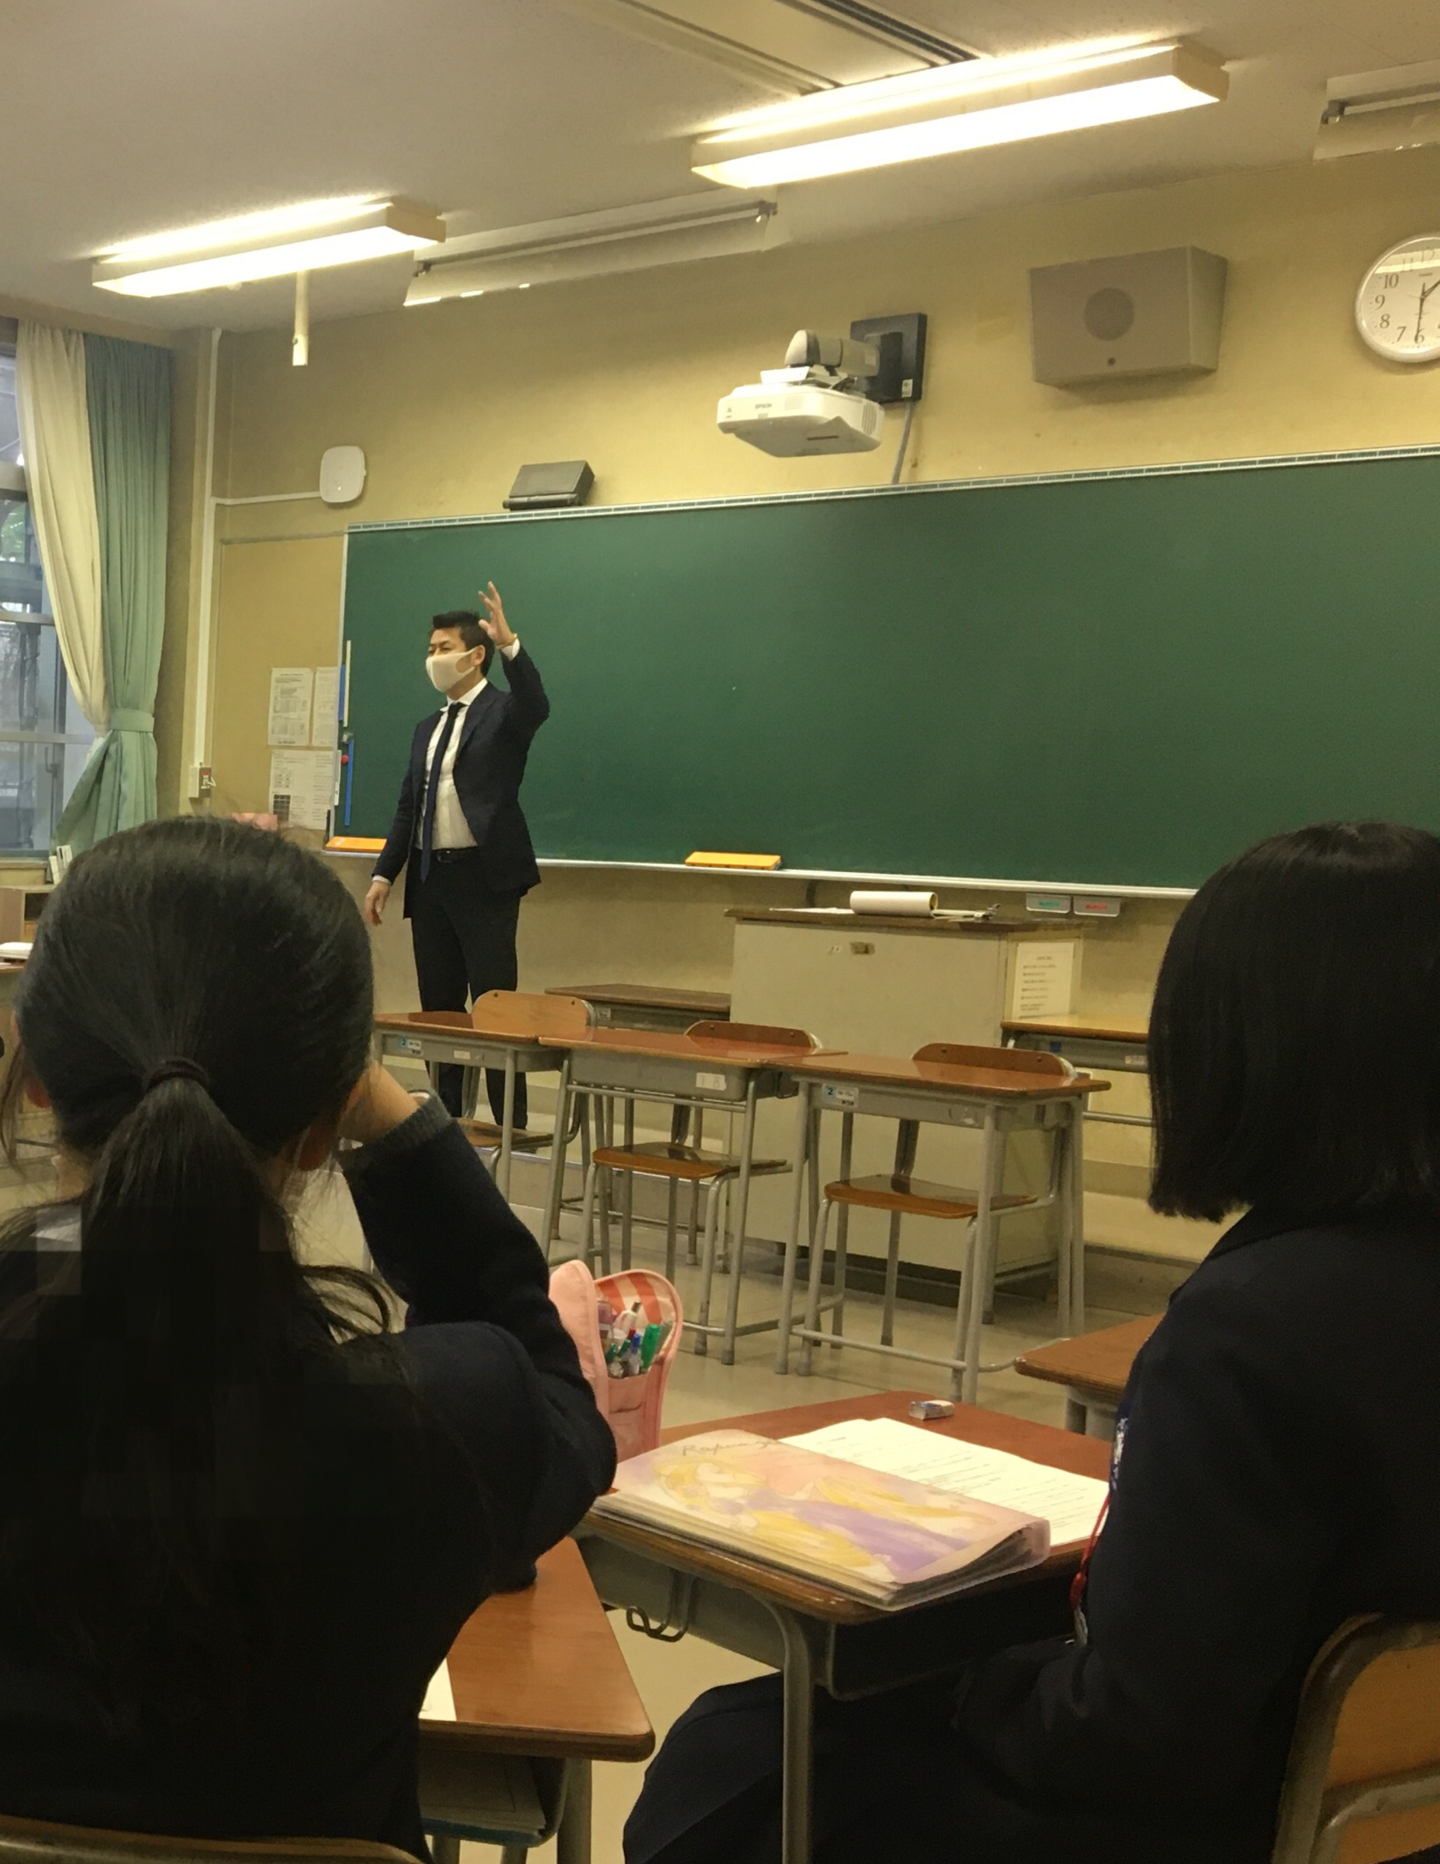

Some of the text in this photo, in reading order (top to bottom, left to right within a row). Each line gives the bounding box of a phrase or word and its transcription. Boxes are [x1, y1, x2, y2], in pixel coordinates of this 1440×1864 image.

[1383, 273, 1399, 289] 10
[1375, 294, 1386, 310] 9
[1379, 313, 1391, 329] 8
[1396, 326, 1407, 342] 7
[1414, 327, 1425, 345] 6
[827, 1087, 834, 1096] 2
